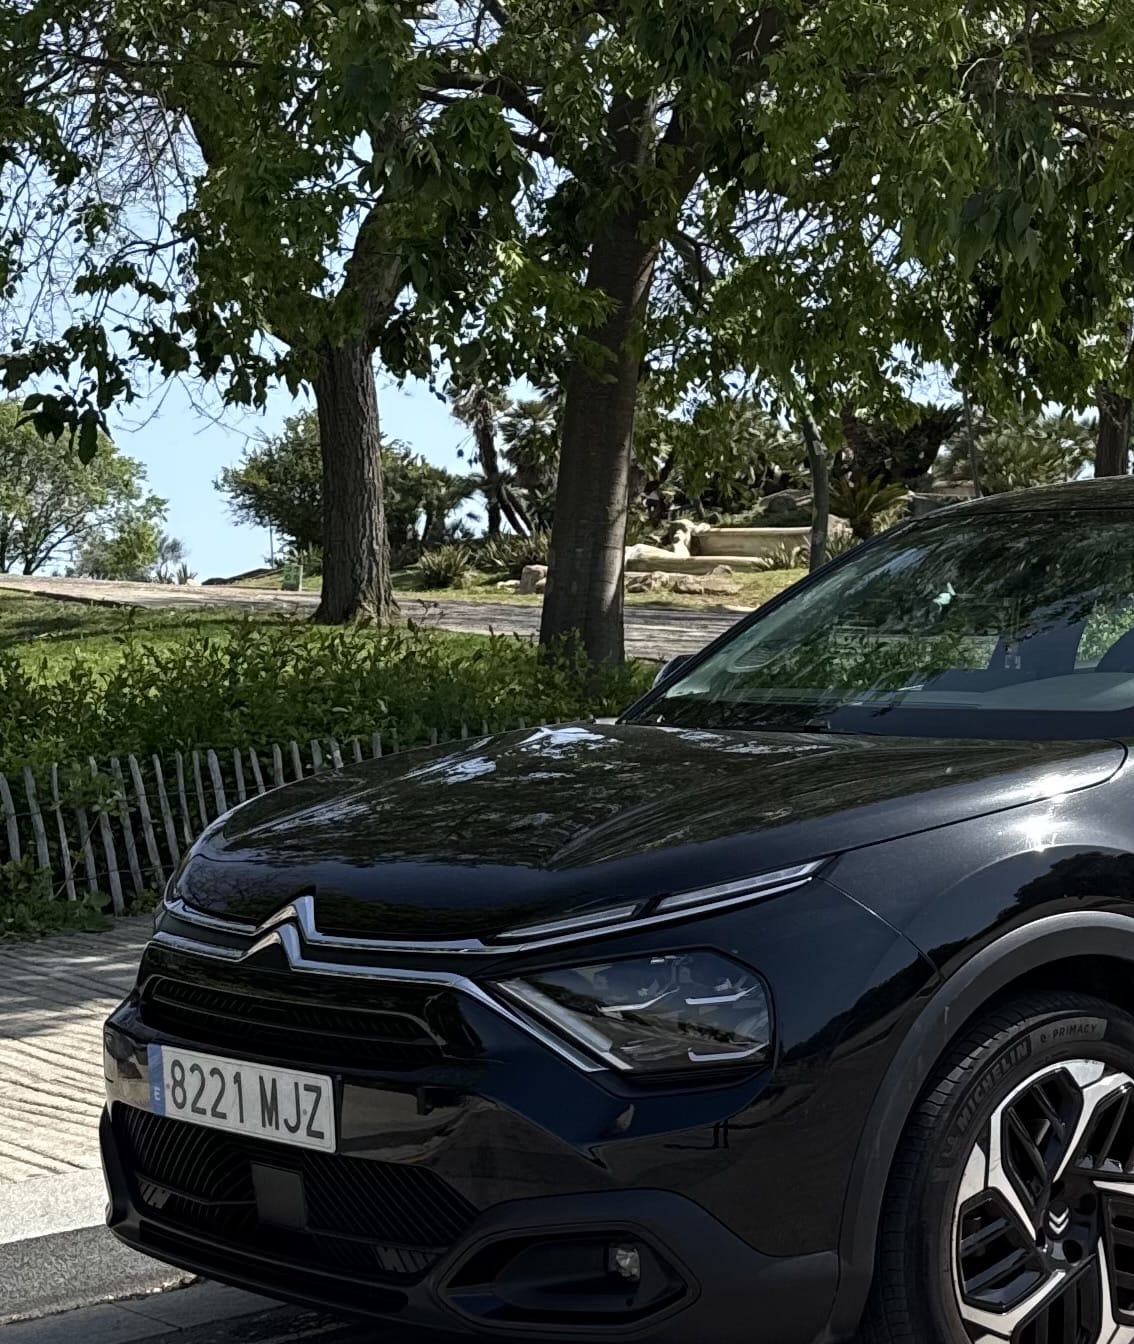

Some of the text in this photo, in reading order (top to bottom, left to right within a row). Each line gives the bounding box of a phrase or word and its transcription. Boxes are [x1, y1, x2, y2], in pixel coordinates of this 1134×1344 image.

[154, 1086, 161, 1101] E
[171, 1059, 325, 1140] 8221 MJZ
[956, 1039, 1030, 1133] MICHELIN
